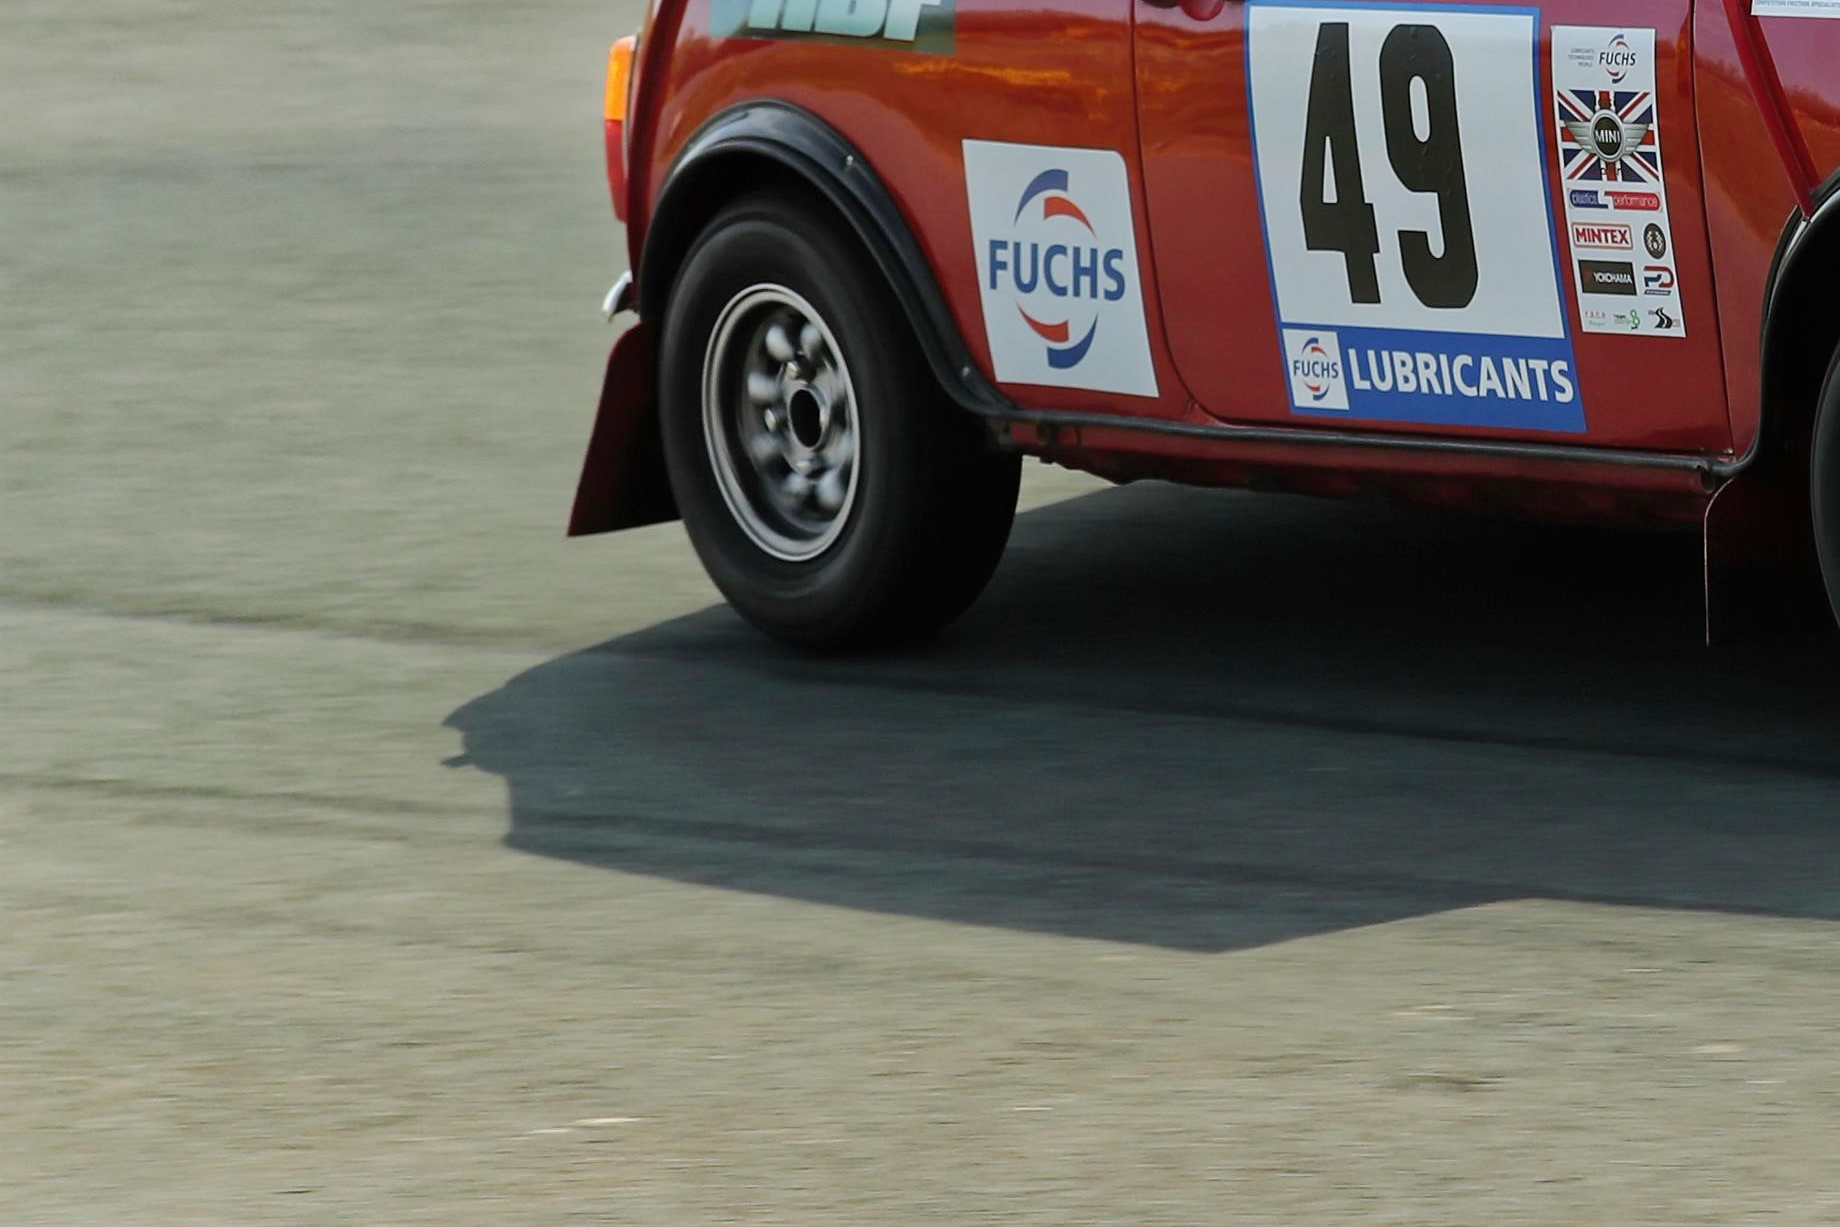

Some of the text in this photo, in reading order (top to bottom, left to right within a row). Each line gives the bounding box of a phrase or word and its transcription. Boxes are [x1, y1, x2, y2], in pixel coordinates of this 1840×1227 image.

[1599, 52, 1636, 67] FUCHS
[1594, 129, 1620, 143] MINI
[1299, 21, 1480, 310] 49
[1575, 227, 1630, 246] MINTEX
[988, 239, 1126, 302] FUCHS
[1293, 348, 1575, 404] FUCHS LUBRICANTS
